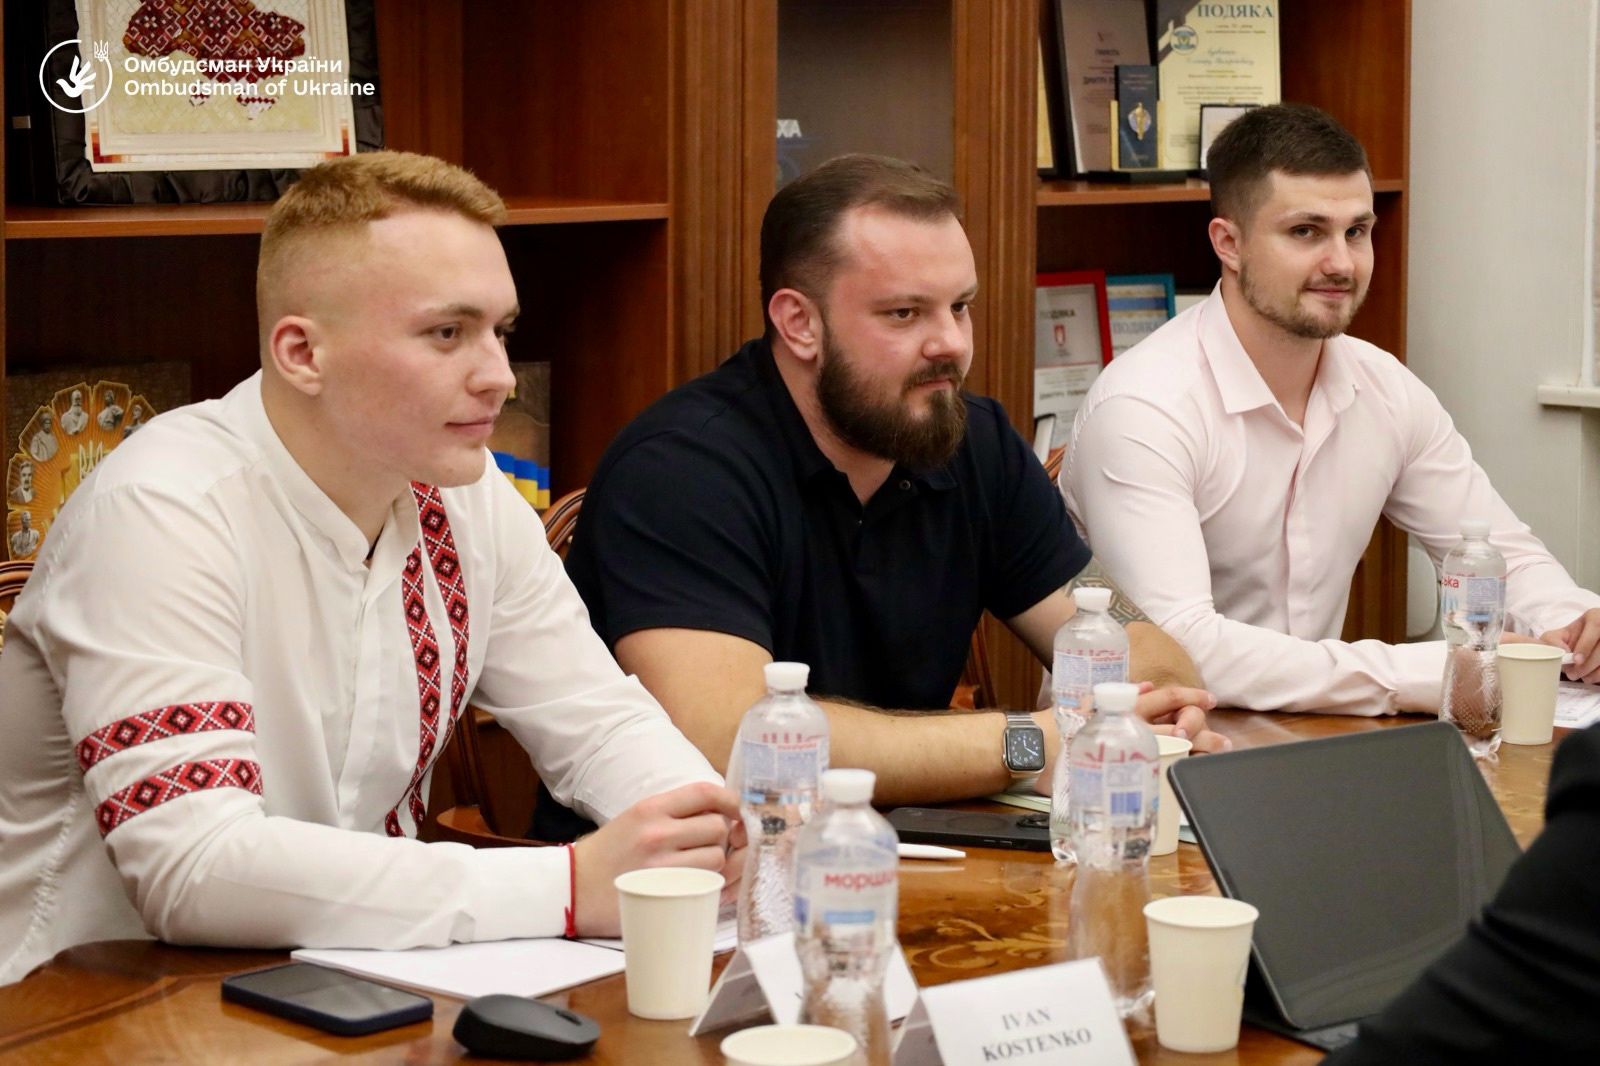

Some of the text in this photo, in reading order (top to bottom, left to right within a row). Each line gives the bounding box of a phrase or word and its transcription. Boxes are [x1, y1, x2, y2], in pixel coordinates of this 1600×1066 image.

[1197, 4, 1274, 19] ПОДЯКА
[1002, 1007, 1052, 1031] IVAN
[982, 1028, 1092, 1061] KOSTENKO
